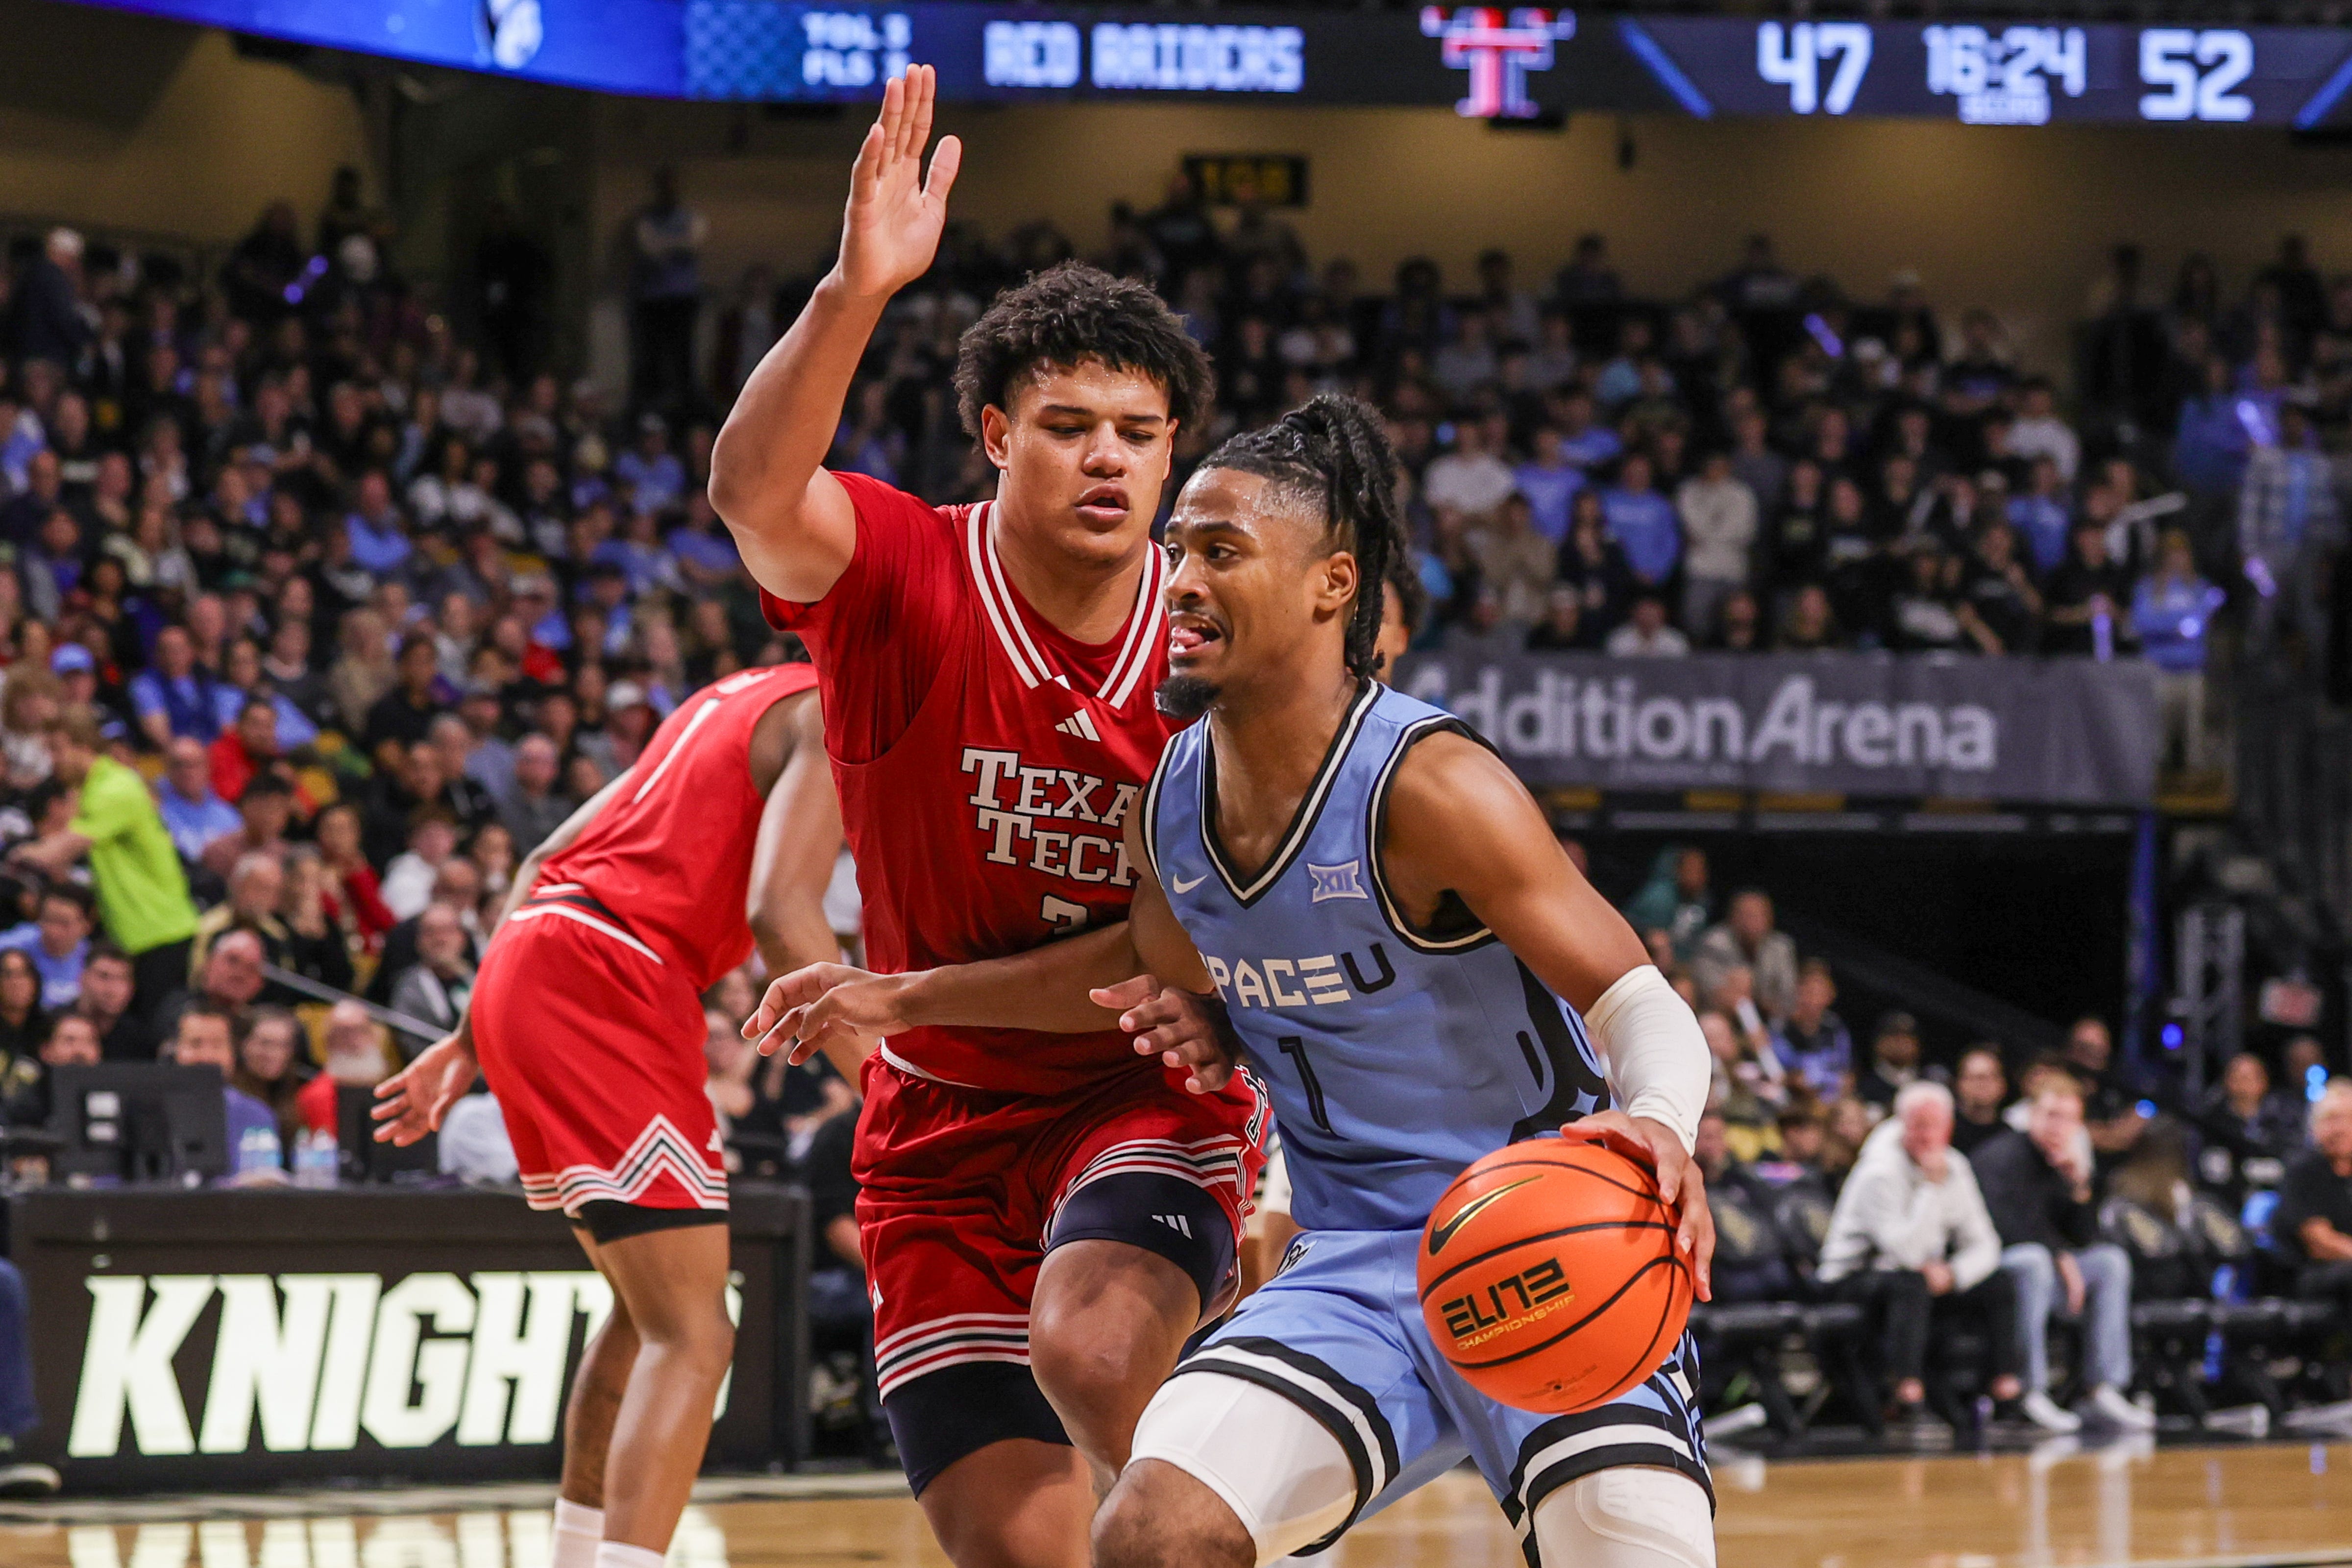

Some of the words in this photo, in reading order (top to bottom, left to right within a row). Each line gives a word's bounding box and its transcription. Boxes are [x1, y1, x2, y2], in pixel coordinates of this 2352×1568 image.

[982, 21, 1079, 87] RED
[1091, 22, 1304, 93] RAIDERS
[1757, 22, 1871, 115] 47
[1922, 24, 2087, 98] 16:24
[2138, 28, 2253, 121] 52
[1749, 675, 1997, 770] Arena
[961, 747, 1138, 828] TEXA
[1198, 943, 1396, 1007] PACEU
[1278, 1036, 1337, 1135] 1
[1441, 1256, 1571, 1339] ELITE
[1457, 1295, 1576, 1351] CHAMPIONSHIP
[68, 1271, 743, 1457] KNIGHT
